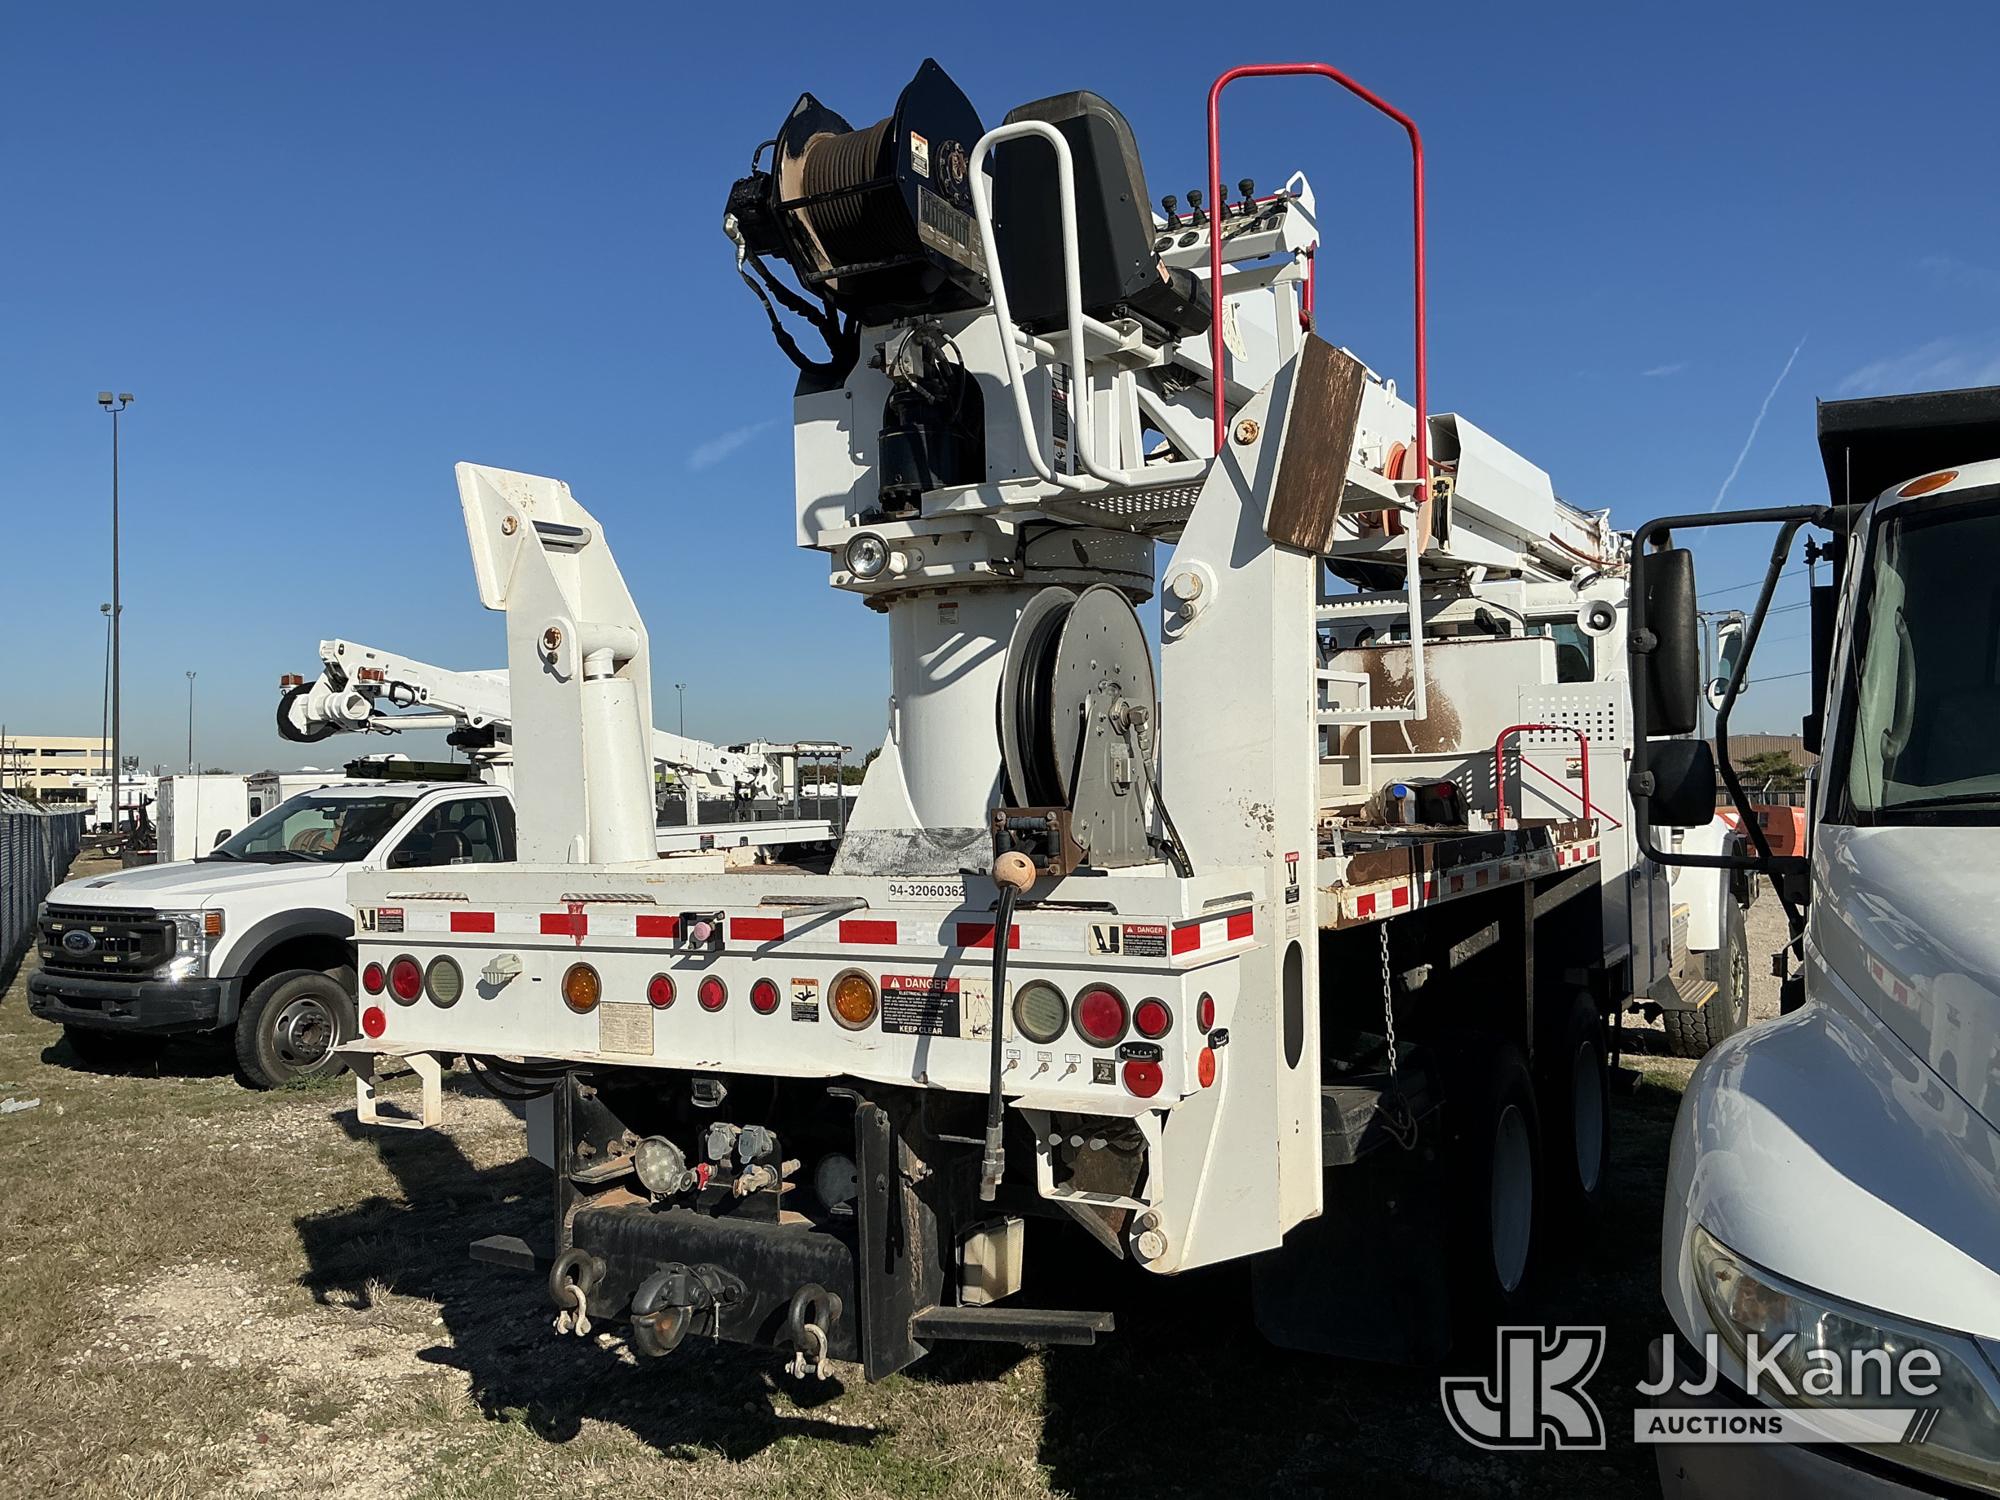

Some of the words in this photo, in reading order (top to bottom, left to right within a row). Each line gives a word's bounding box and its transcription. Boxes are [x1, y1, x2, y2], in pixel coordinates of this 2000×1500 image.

[889, 884, 966, 896] 94-32060362
[1137, 926, 1163, 934] DANGER
[905, 977, 948, 990] DANGER
[899, 1025, 917, 1034] KEEP
[919, 1026, 943, 1035] CLEAR
